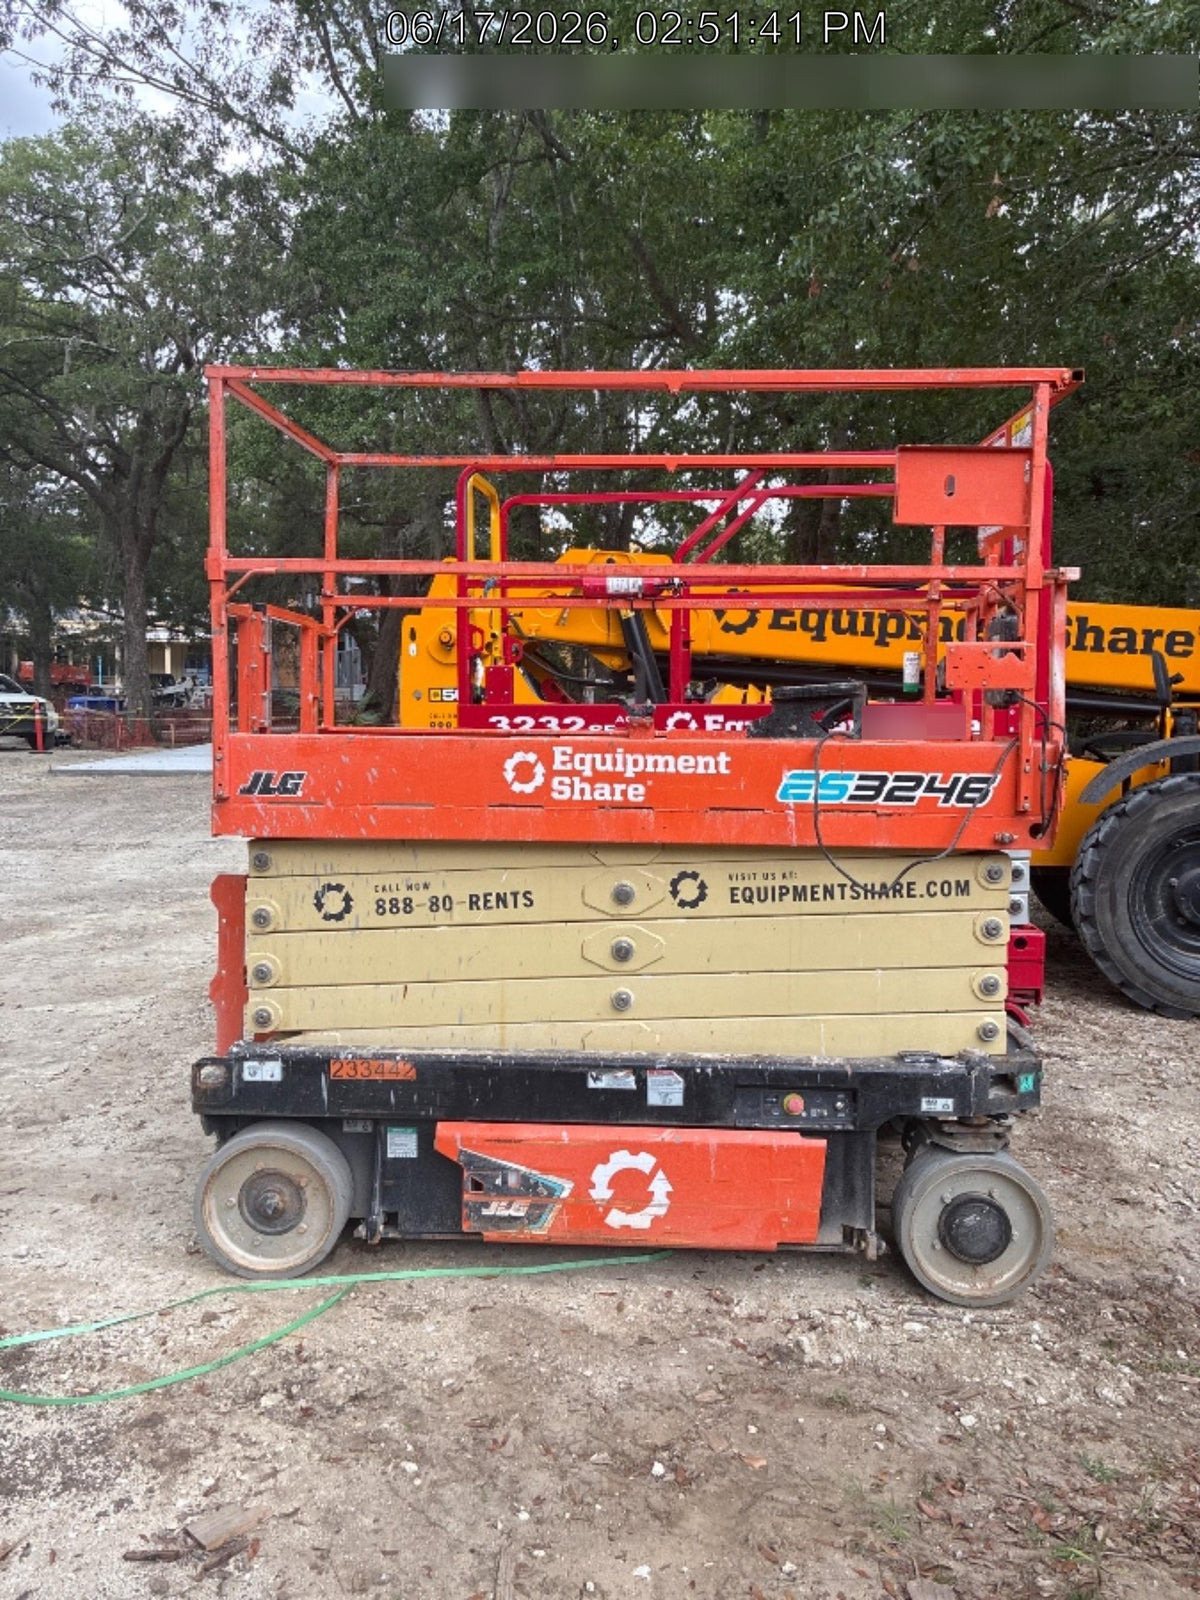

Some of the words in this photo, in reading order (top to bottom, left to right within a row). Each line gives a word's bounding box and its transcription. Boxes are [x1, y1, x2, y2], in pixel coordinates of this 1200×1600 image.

[552, 746, 732, 777] Equipment
[237, 769, 307, 797] JLG
[551, 776, 647, 802] Share
[776, 769, 1002, 807] ES3246
[374, 882, 401, 893] CALL
[405, 881, 431, 892] NOW
[728, 872, 757, 881] VISIT
[762, 872, 776, 881] US
[728, 879, 970, 905] EQUIPMENTSHARE.COM
[331, 1060, 415, 1078] 233442
